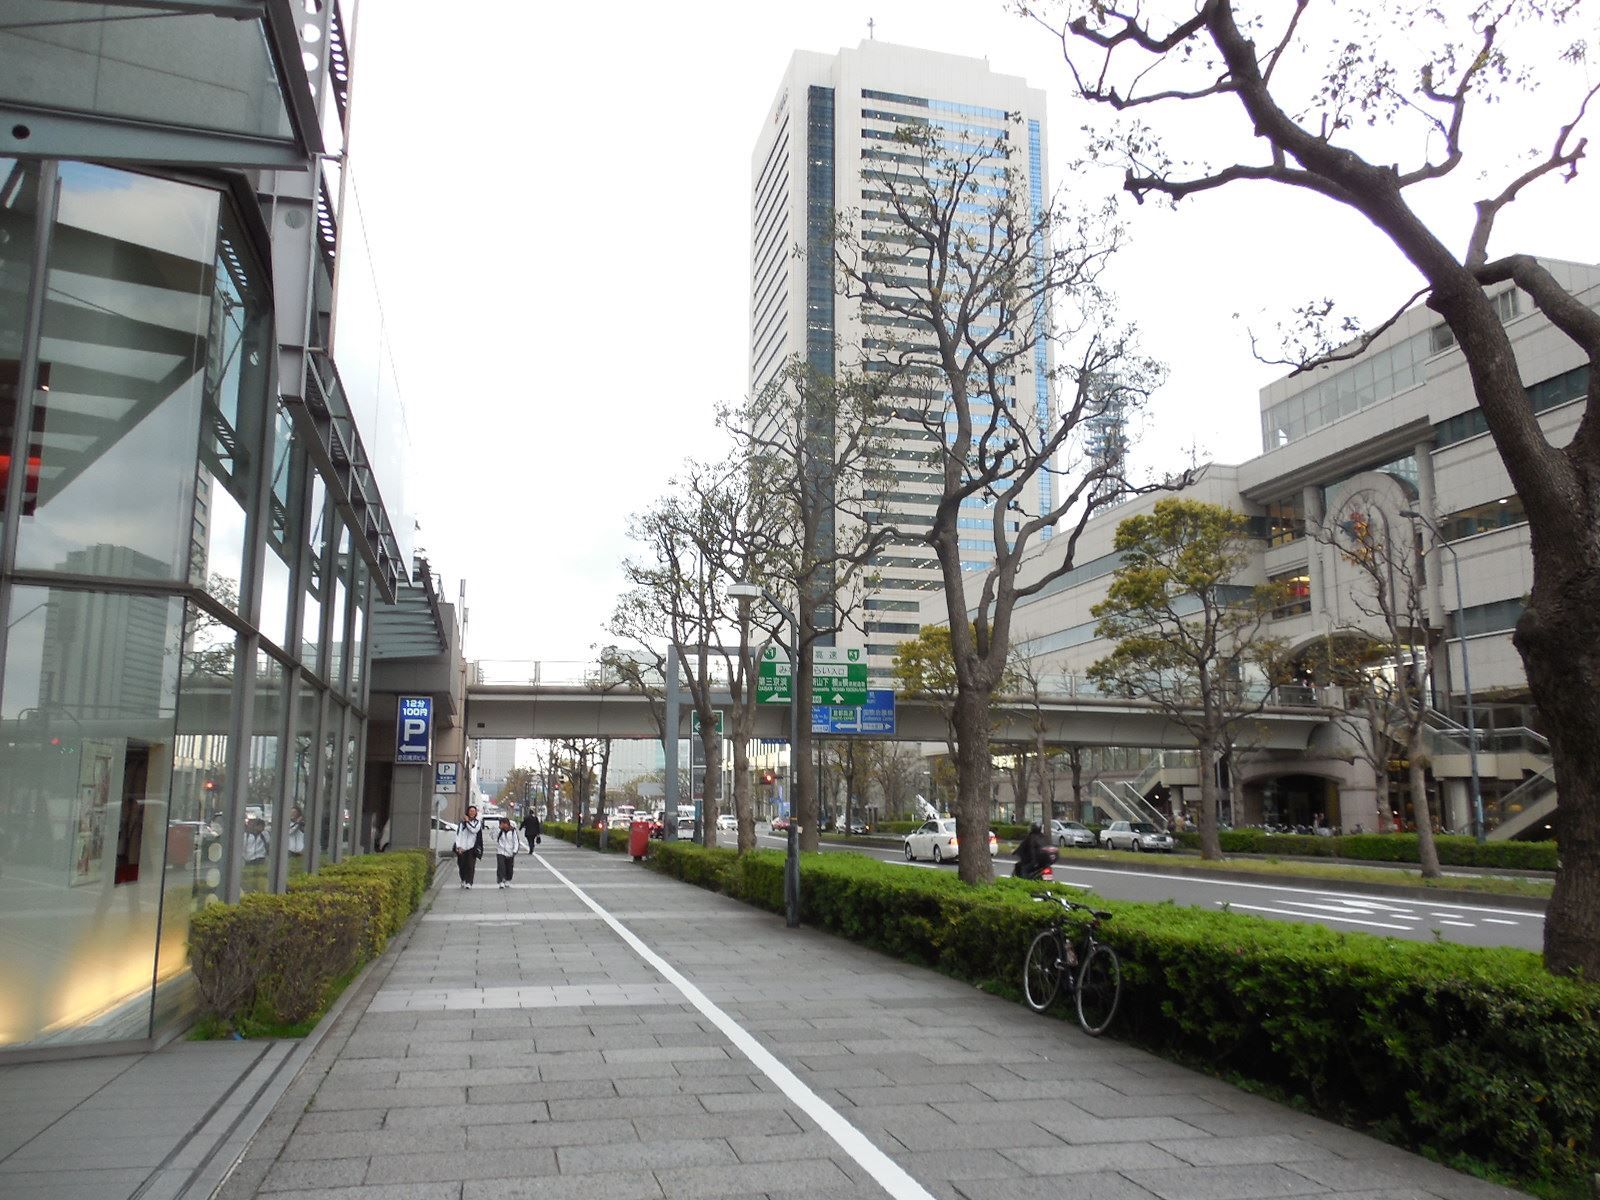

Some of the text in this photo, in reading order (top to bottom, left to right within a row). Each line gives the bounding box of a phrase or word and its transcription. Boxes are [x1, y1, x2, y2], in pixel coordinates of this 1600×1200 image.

[403, 708, 428, 717] 100円
[404, 719, 426, 742] P
[443, 765, 451, 773] P
